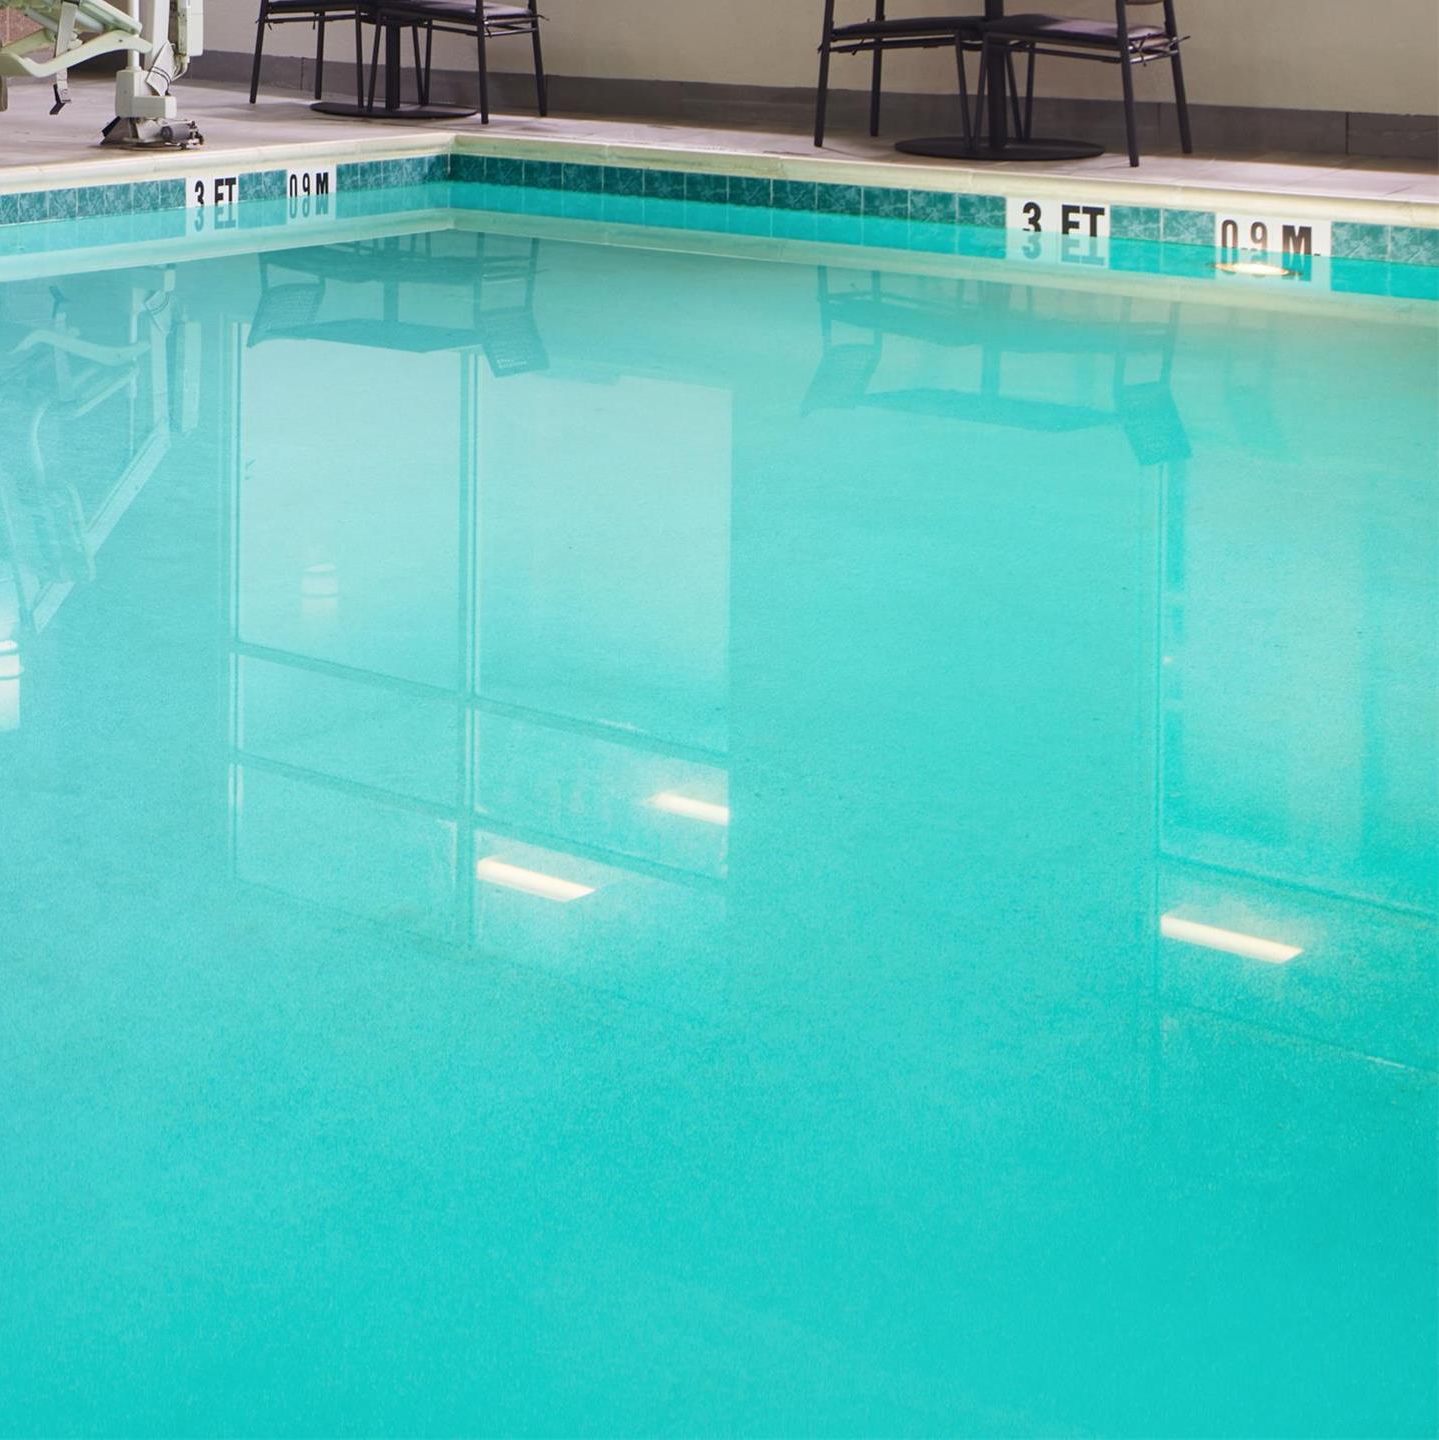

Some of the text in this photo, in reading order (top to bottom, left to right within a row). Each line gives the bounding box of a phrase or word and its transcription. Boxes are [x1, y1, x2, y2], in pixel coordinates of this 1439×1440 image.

[194, 177, 237, 207] 3 FT
[289, 173, 310, 197] 09
[1022, 201, 1105, 237] 3 FT
[1221, 219, 1268, 251] 09
